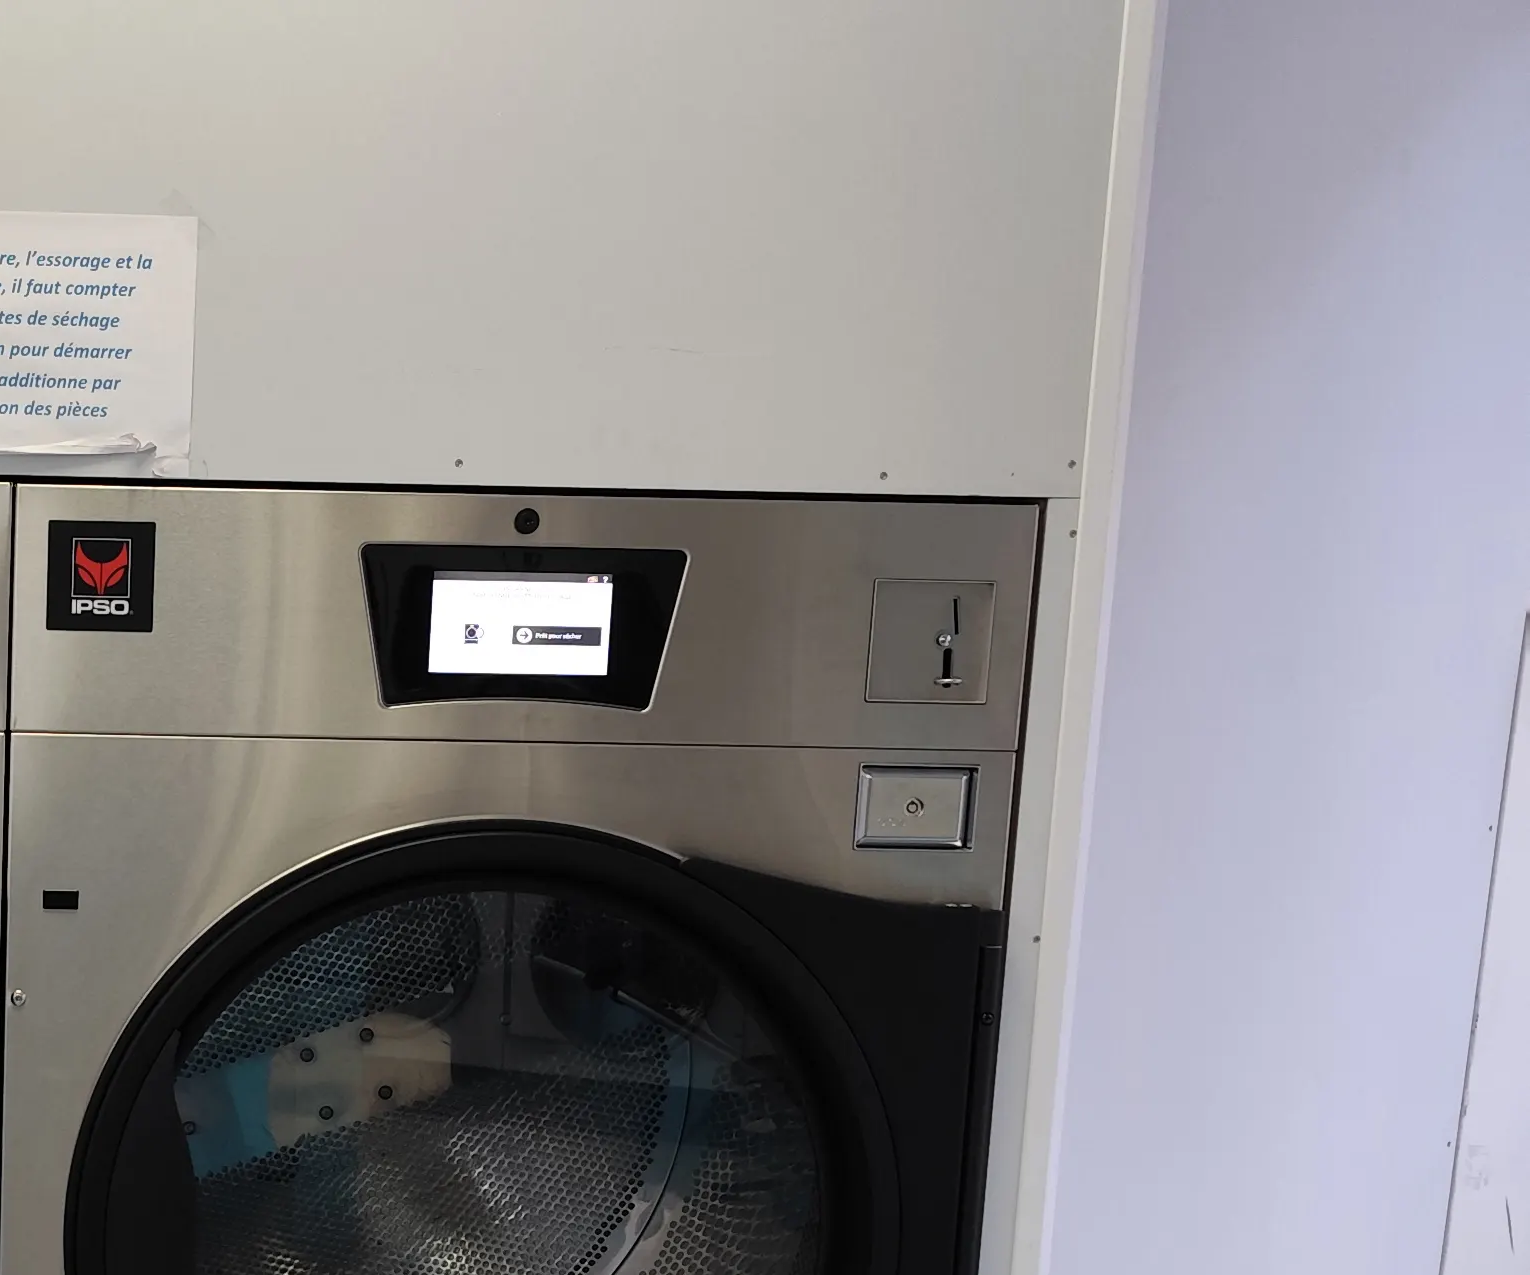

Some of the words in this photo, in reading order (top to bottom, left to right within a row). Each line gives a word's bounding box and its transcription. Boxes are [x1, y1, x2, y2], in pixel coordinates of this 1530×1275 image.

[25, 250, 111, 272] l'essorage
[115, 255, 134, 270] et
[136, 253, 153, 270] la
[11, 278, 23, 294] il
[23, 278, 62, 298] faut
[65, 282, 137, 300] compter
[26, 309, 48, 326] de
[51, 310, 121, 332] séchage
[8, 344, 50, 360] pour
[53, 342, 133, 360] démarrer
[91, 378, 122, 394] par
[23, 400, 53, 416] des
[55, 400, 108, 420] pièces
[71, 598, 130, 616] IPSO
